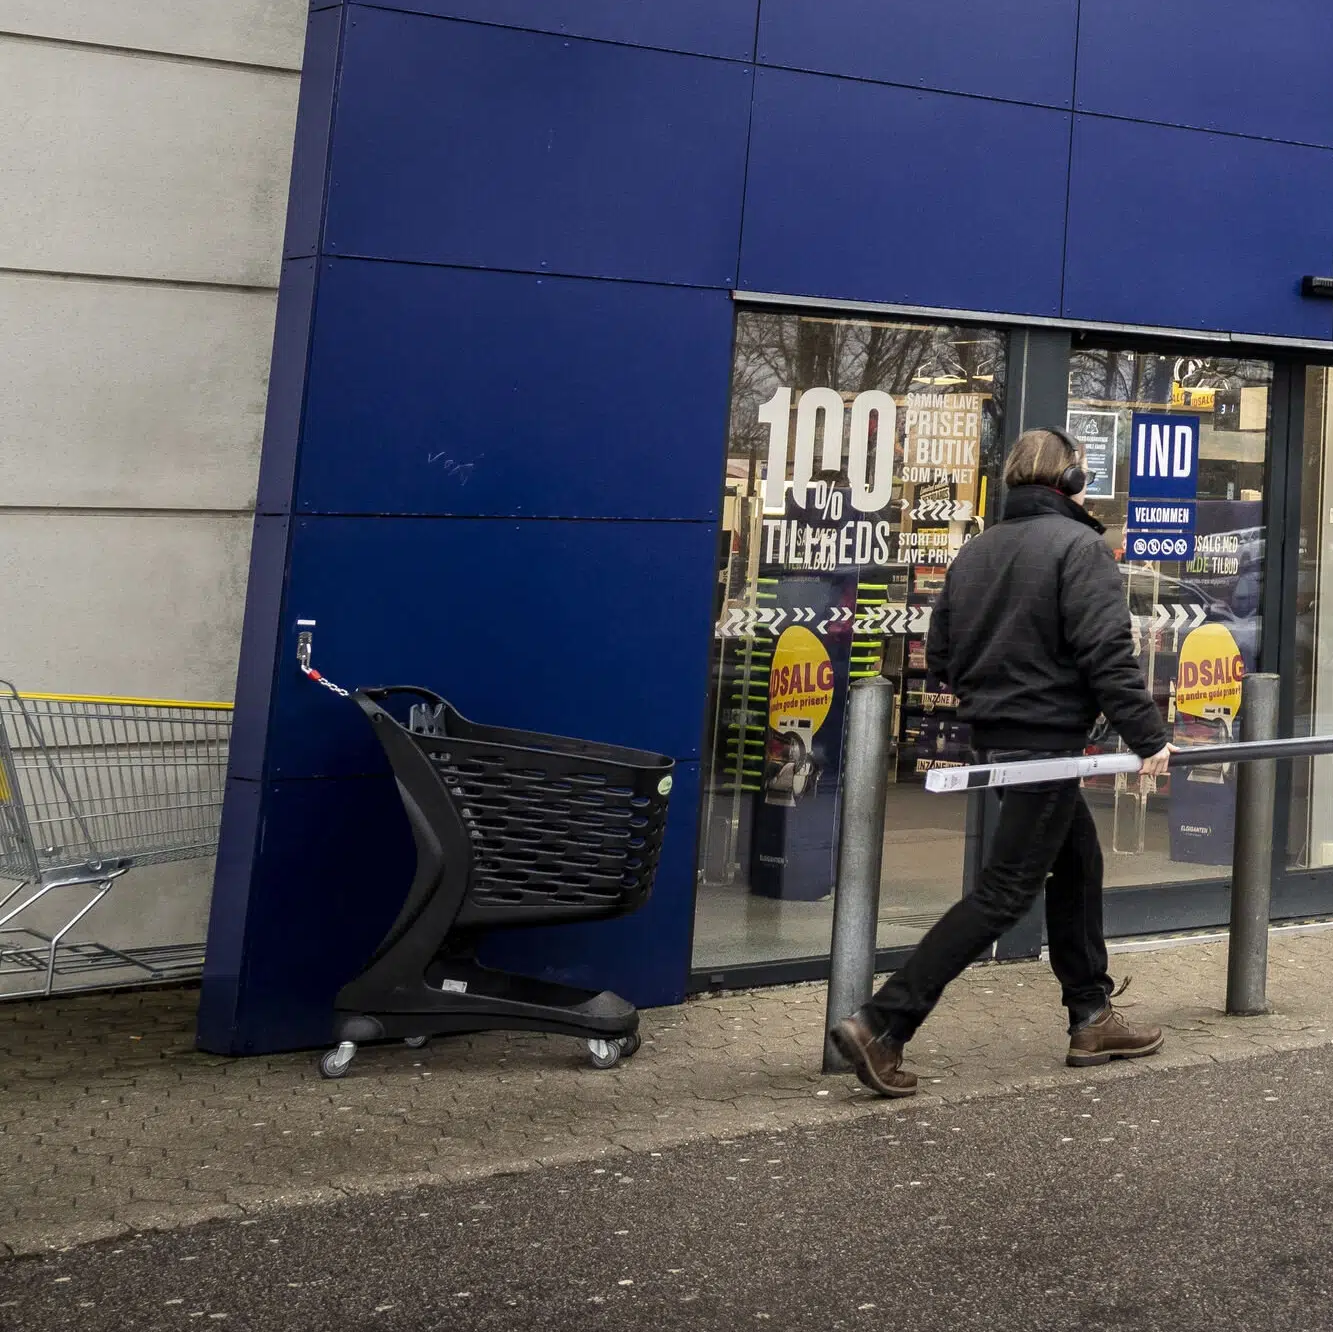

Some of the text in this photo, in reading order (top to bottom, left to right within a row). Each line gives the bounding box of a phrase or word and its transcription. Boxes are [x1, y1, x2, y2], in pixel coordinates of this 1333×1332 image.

[906, 393, 979, 410] SAMME LAVE
[905, 409, 978, 437] PRISER
[758, 386, 897, 513] 100
[903, 437, 976, 466] I BUTIK
[1136, 423, 1193, 478] IND
[902, 465, 974, 485] SOM PÅ NET
[814, 480, 843, 521] %
[1135, 506, 1190, 524] VELKOMMEN
[763, 520, 890, 565] TILFREDS
[899, 532, 973, 547] STORT UDLG
[1194, 534, 1238, 553] SALG MED
[897, 548, 955, 564] LAVE PRIS
[1212, 558, 1239, 575] TILBUD
[800, 693, 828, 711] priser!
[1185, 689, 1208, 702] andre
